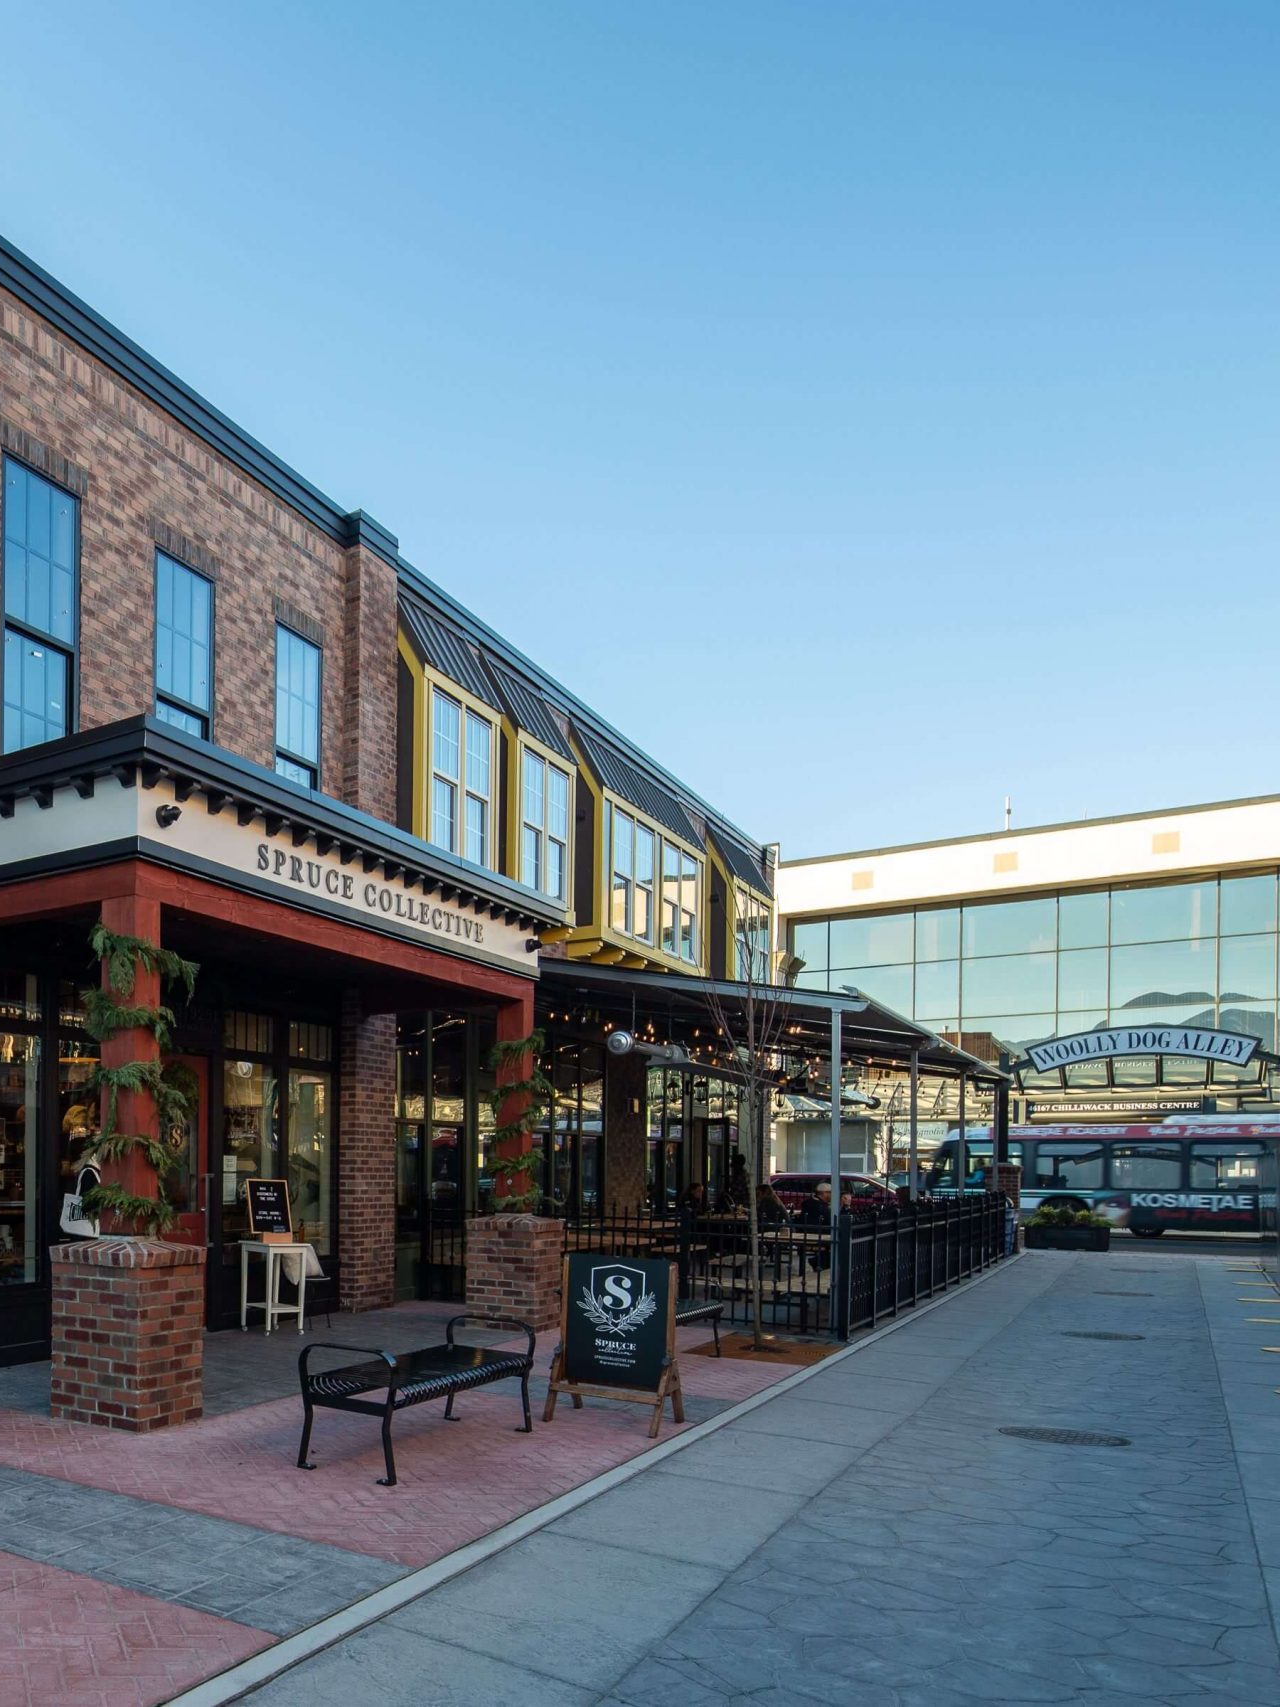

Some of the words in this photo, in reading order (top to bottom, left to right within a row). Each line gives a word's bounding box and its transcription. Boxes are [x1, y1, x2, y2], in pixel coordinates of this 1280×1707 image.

[257, 842, 354, 900] SPRUCE
[364, 883, 484, 944] COLLECTIVE
[1034, 1033, 1122, 1065] WOOLLY
[1127, 1031, 1172, 1049] DOG
[1176, 1032, 1252, 1059] ALLEY
[1028, 1104, 1050, 1113] 46167
[1051, 1102, 1112, 1112] CHILLIWACK
[1113, 1101, 1158, 1111] BUSINESS
[1159, 1101, 1200, 1110] CENTRE
[1130, 1192, 1254, 1212] KOSMETAE
[603, 1275, 632, 1310] S
[594, 1337, 637, 1351] SPRUCE
